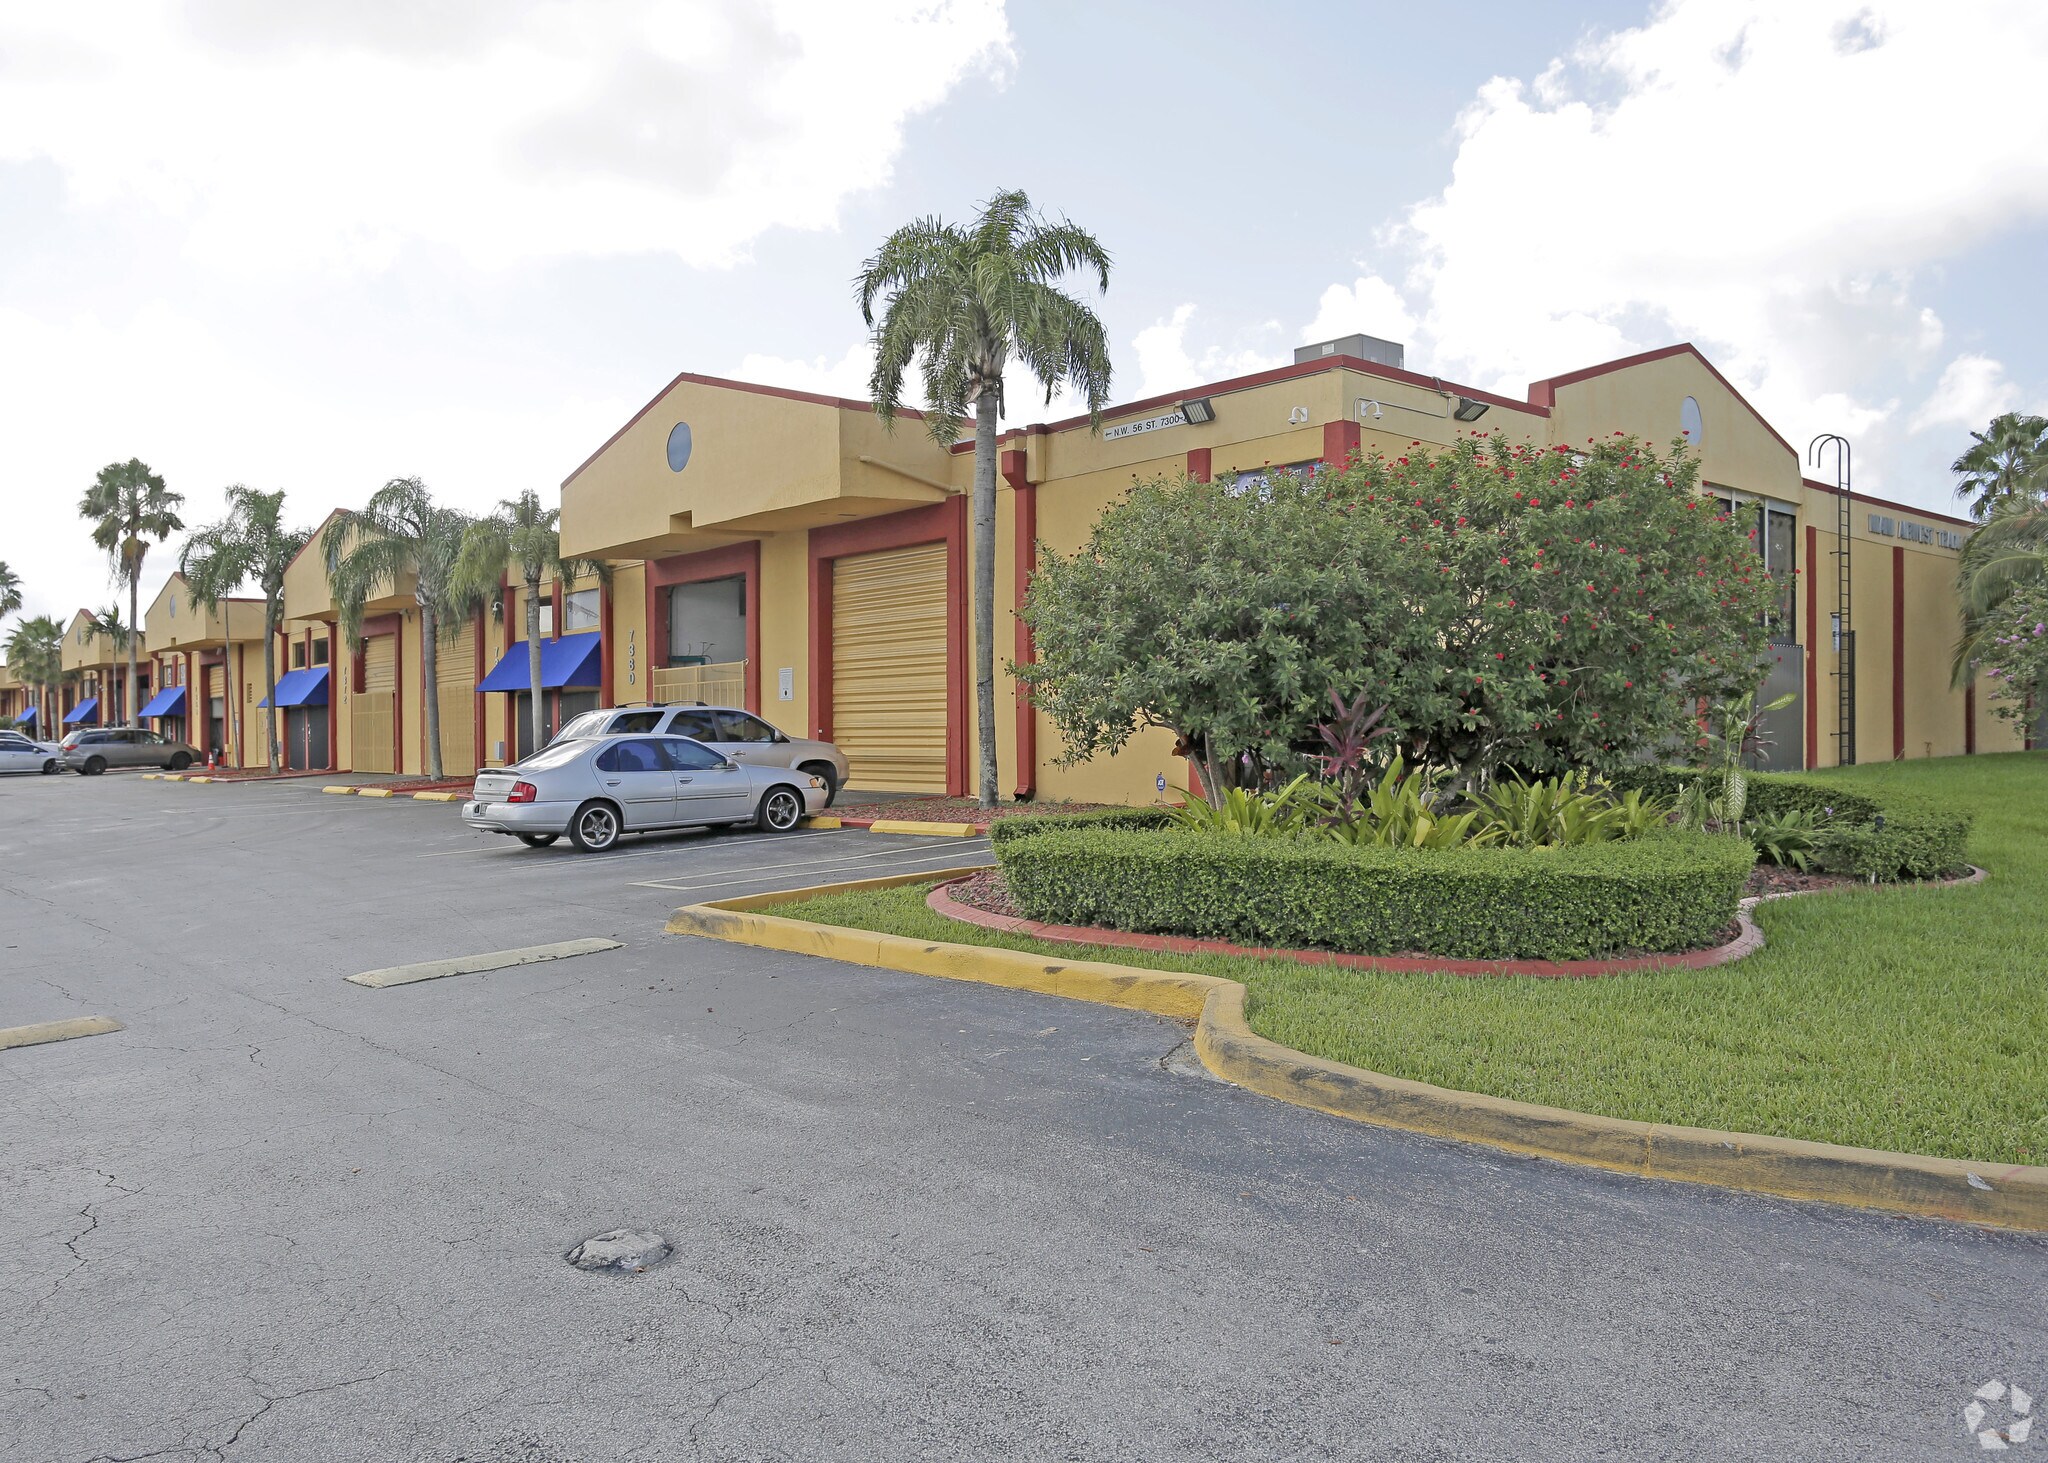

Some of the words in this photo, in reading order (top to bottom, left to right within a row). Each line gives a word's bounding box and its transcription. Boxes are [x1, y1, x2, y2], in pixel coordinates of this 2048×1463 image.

[1114, 427, 1130, 437] N.W.
[1132, 423, 1143, 433] 56
[1145, 420, 1158, 430] ST.
[628, 628, 636, 686] 7380
